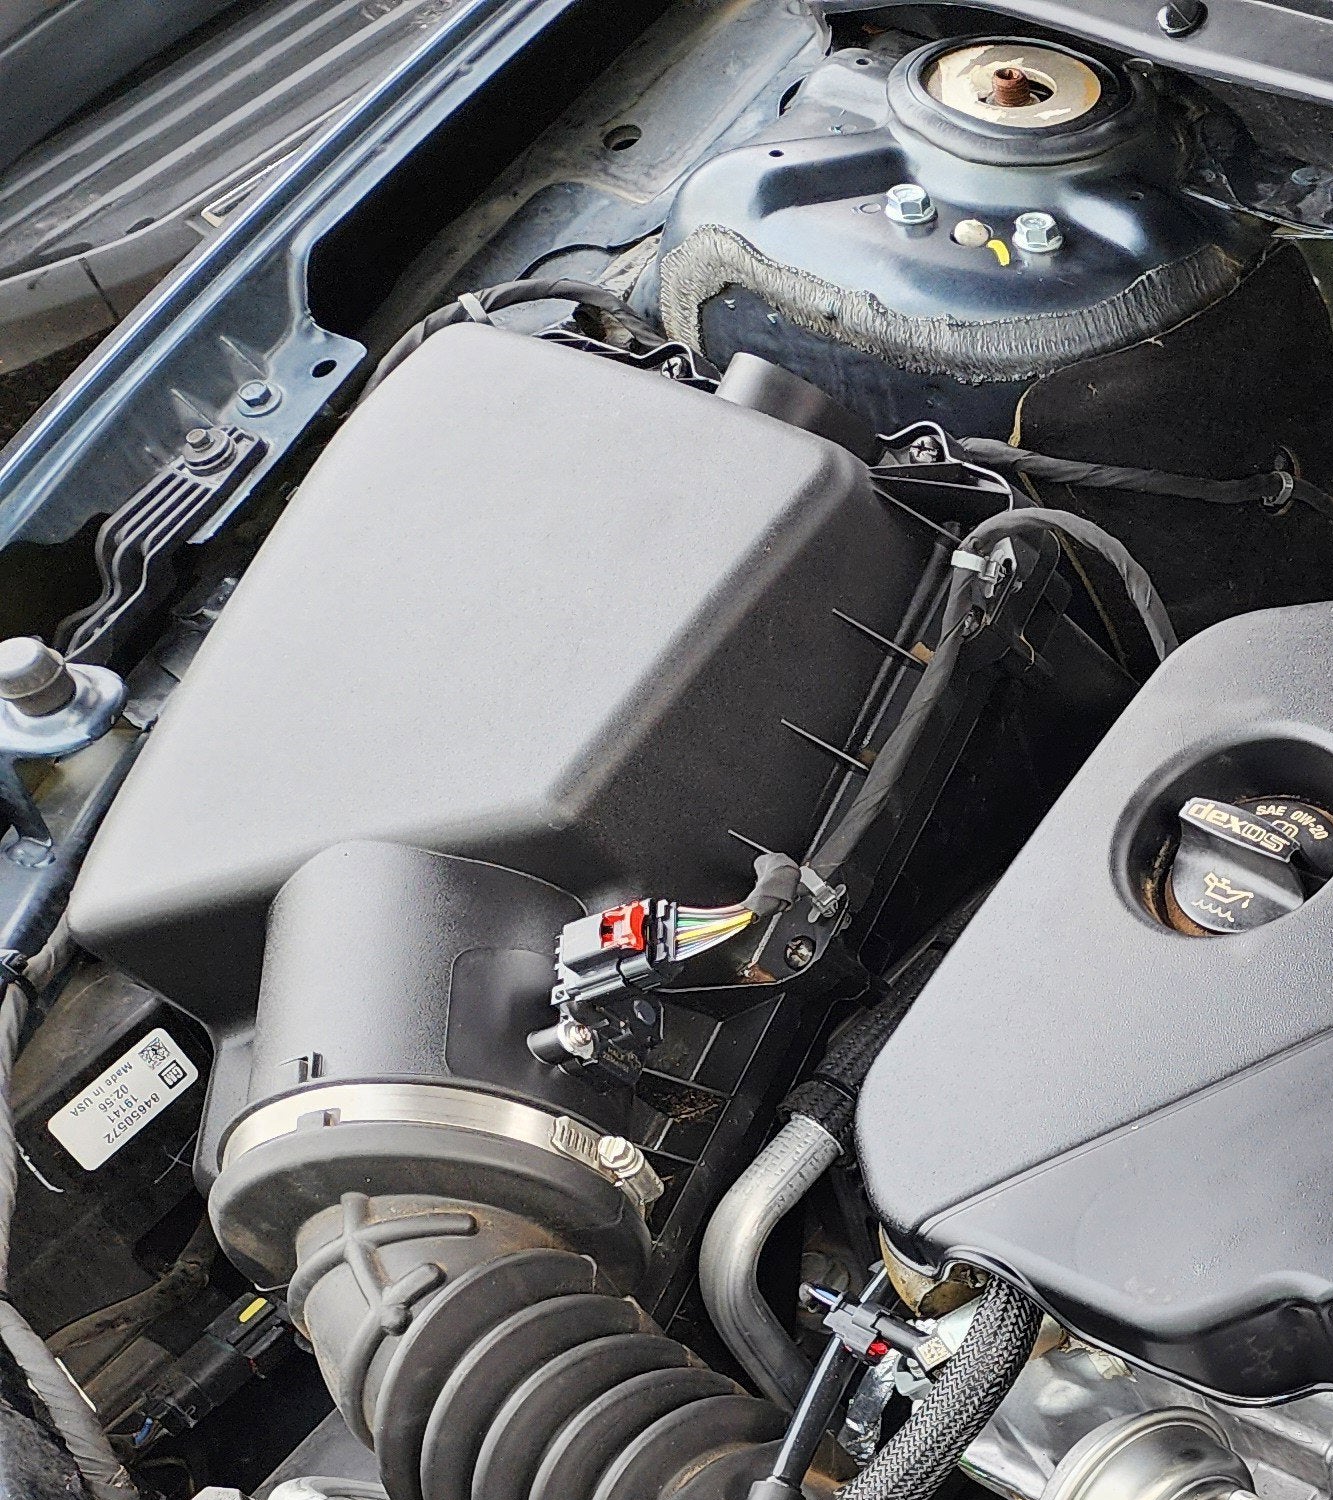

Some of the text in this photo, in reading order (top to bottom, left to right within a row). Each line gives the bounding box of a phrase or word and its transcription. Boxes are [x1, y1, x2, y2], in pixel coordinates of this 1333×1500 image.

[1188, 802, 1290, 853] dexos
[1256, 805, 1329, 840] SAE 0W-20
[106, 1062, 133, 1087] Made
[70, 1098, 93, 1117] USA
[98, 1084, 129, 1112] 02:56
[107, 1095, 139, 1124] 19141
[103, 1093, 161, 1144] 84650572
